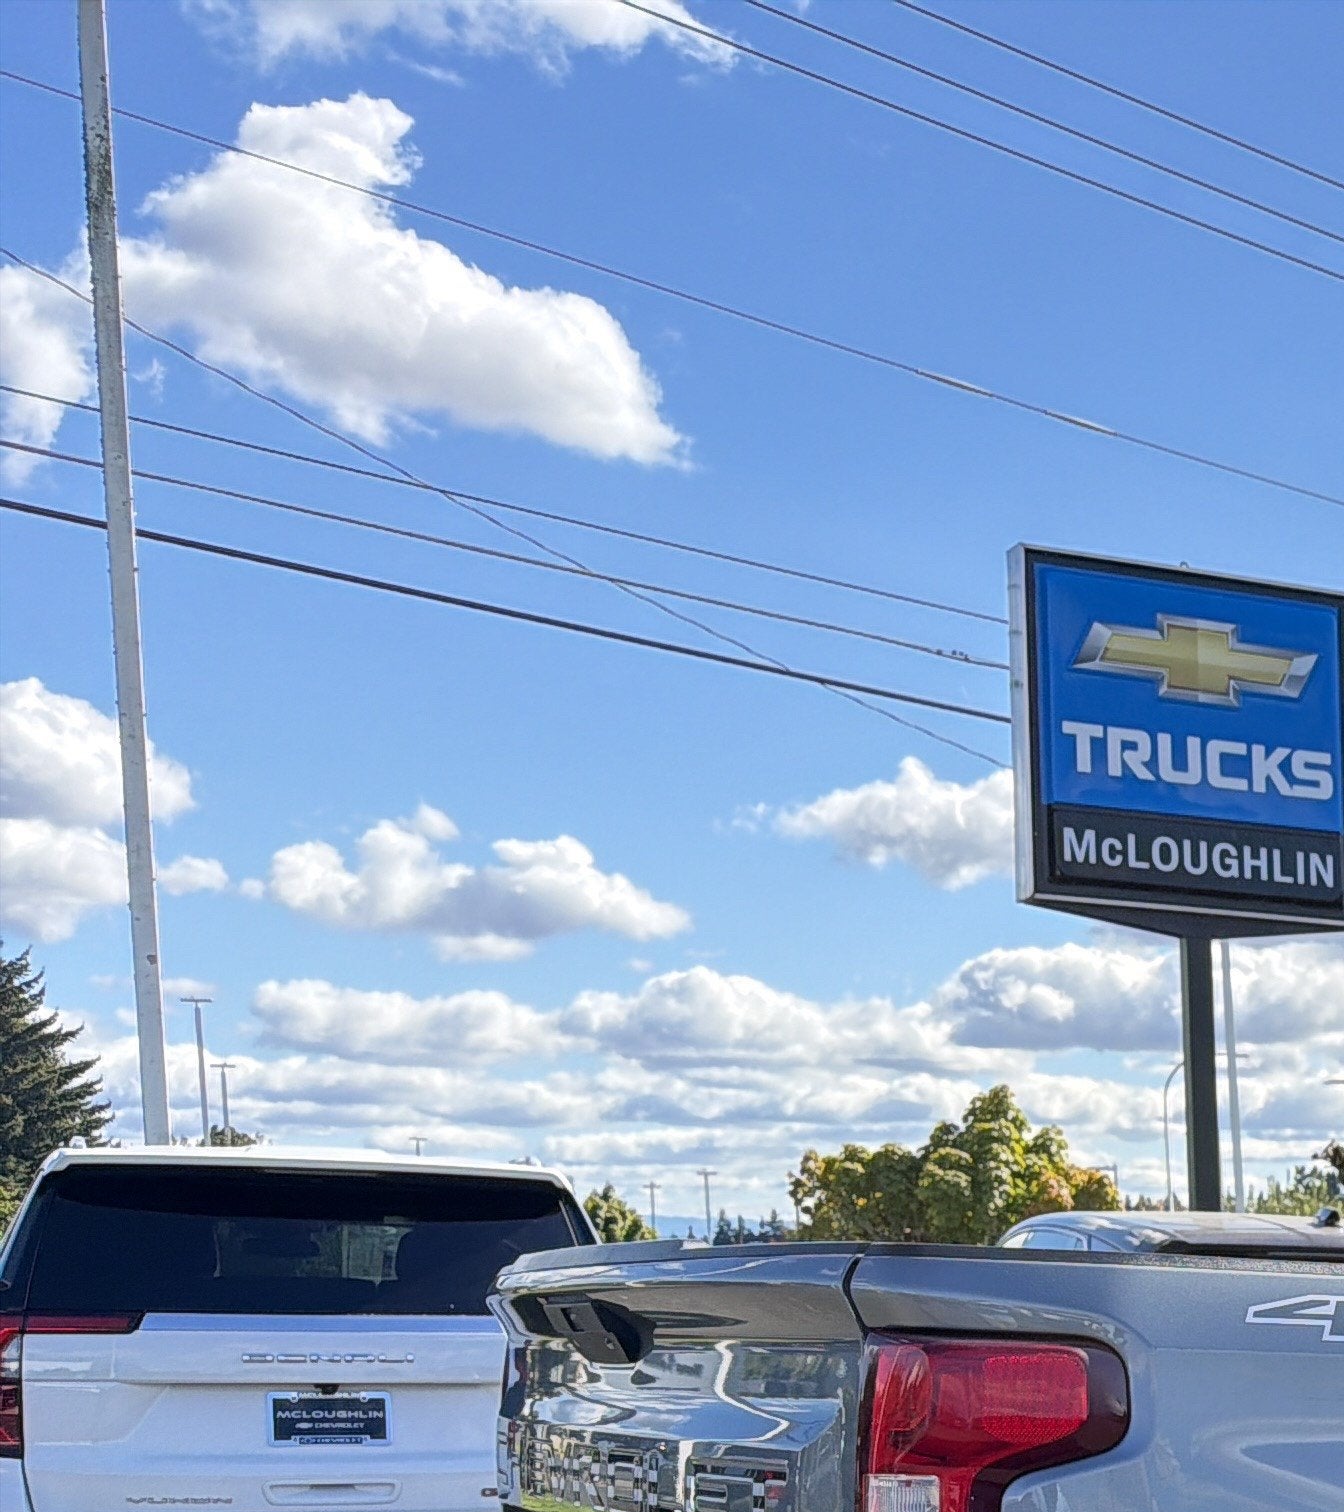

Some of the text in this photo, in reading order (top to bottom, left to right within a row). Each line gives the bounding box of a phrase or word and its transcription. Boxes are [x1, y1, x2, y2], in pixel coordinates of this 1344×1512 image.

[1062, 720, 1334, 800] TRUCKS
[1062, 826, 1335, 888] McLOUGHLIN
[276, 1410, 383, 1419] MCLOUGHLIN
